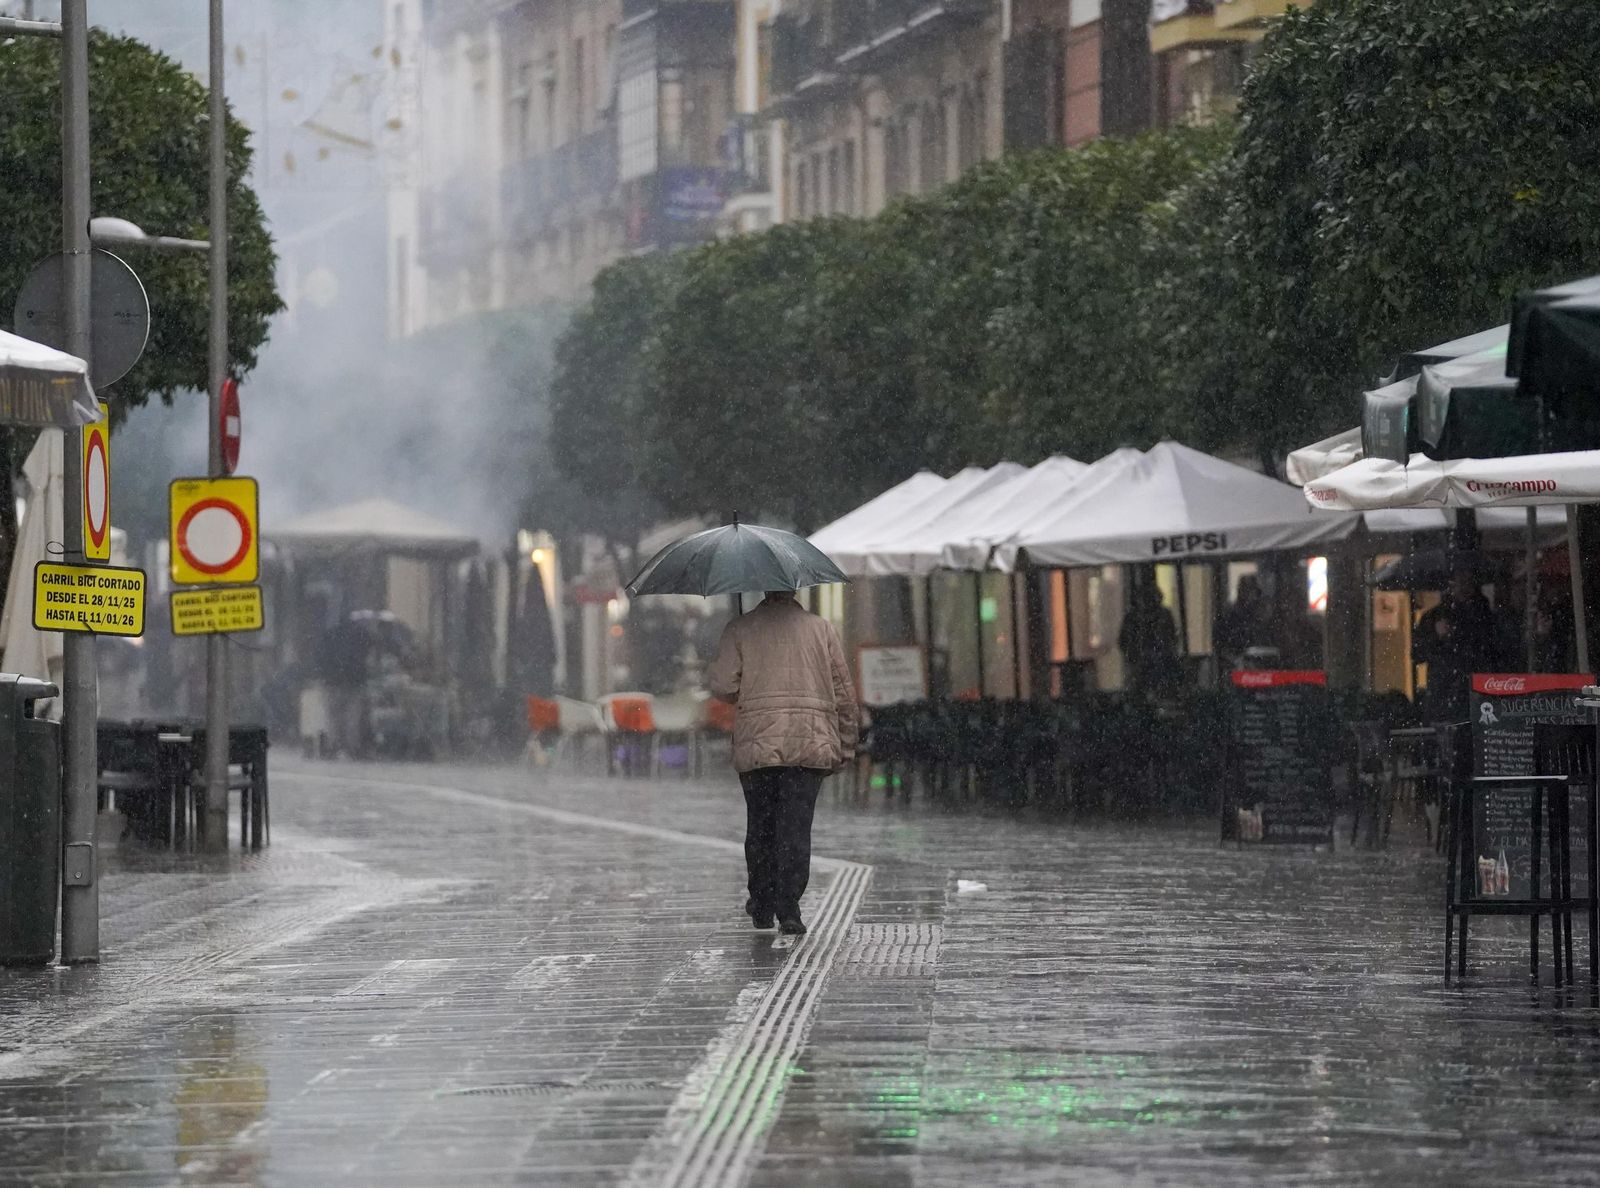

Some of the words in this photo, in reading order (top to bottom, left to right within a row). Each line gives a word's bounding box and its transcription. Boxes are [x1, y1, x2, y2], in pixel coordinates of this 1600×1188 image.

[1466, 479, 1557, 494] Cruzcampo
[1151, 531, 1228, 554] PEPSI
[41, 573, 75, 586] CARRIL
[98, 577, 141, 591] CORTADO
[46, 591, 77, 604] DESDE
[78, 593, 89, 605] EL
[91, 594, 135, 609] 28/11/25
[46, 608, 75, 622] HASTA
[77, 611, 88, 622] EL
[90, 611, 134, 626] 11/01/26
